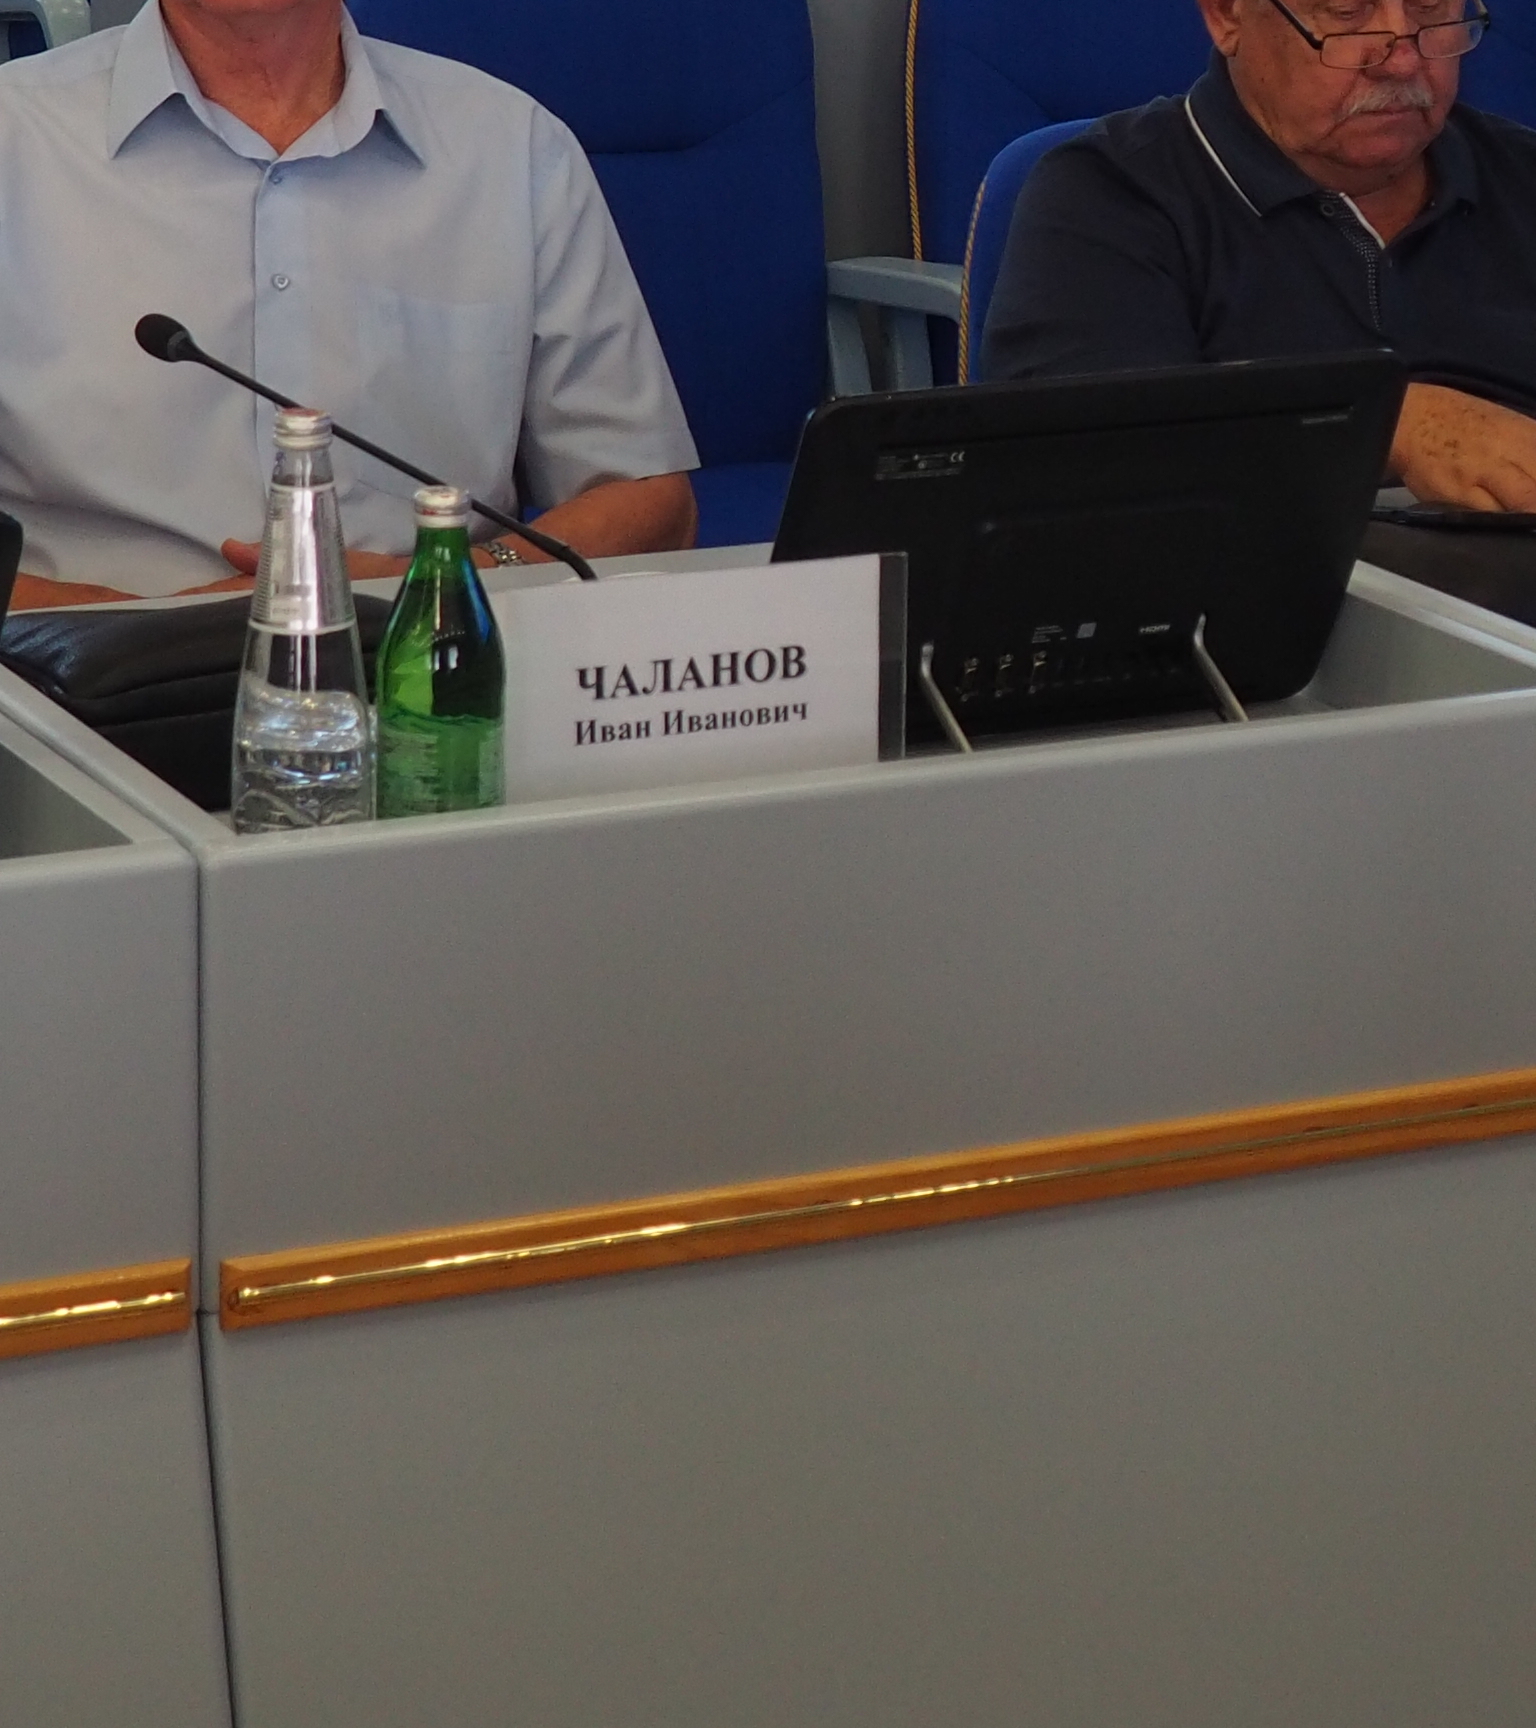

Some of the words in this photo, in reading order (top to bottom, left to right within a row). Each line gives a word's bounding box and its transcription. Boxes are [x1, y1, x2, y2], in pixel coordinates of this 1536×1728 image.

[576, 645, 808, 701] ЧАЛАНОВ
[574, 718, 652, 747] Иван
[662, 702, 809, 737] Иванович
